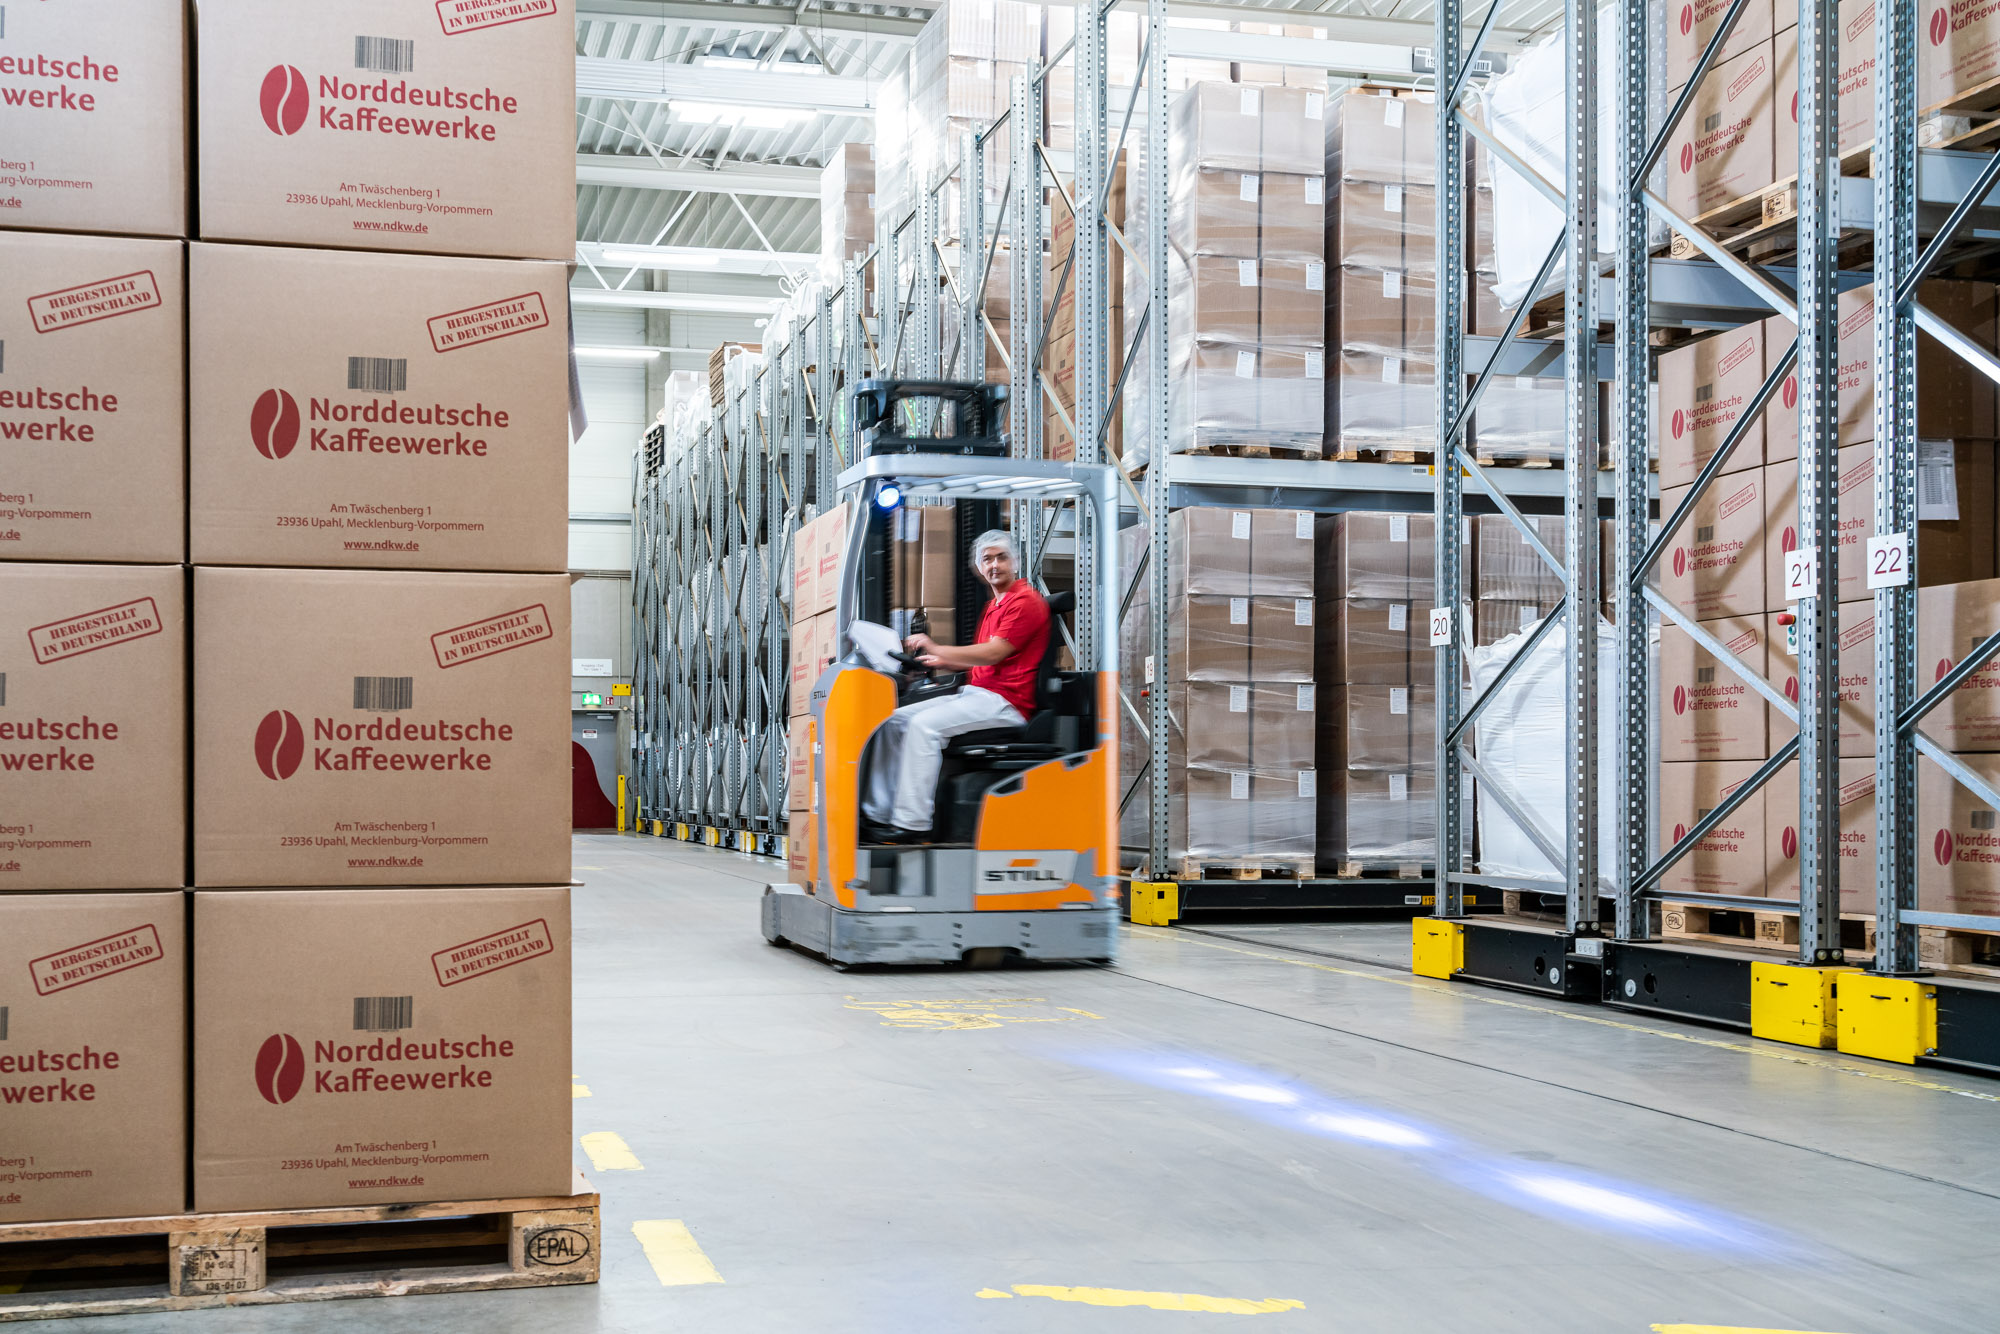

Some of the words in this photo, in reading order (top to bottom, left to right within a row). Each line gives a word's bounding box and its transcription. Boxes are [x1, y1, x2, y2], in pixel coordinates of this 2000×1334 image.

[449, 17, 463, 28] IN
[465, 0, 548, 25] DEUTSCHLAND
[319, 75, 518, 113] Norddeutsche
[319, 105, 496, 141] Kaffeewerke
[1694, 116, 1752, 150] Norddeutsche
[1694, 133, 1745, 165] Kaffeewerke
[29, 161, 35, 171] 1
[339, 182, 357, 193] Am
[359, 183, 433, 200] Twäschenberg
[435, 188, 441, 198] 1
[286, 193, 318, 205] 23936
[320, 195, 354, 208] Upahl,
[356, 198, 493, 216] Mecklenburg-Vorpommern
[353, 219, 429, 234] www.ndkw.de
[49, 280, 136, 309] HERGESTELLT
[42, 313, 58, 325] IN
[61, 291, 151, 322] DEUTSCHLAND
[446, 301, 526, 330] HERGESTELLT
[440, 333, 454, 346] IN
[457, 311, 540, 342] DEUTSCHLAND
[310, 397, 510, 428] Norddeutsche
[1686, 395, 1742, 419] Norddeutsche
[1686, 411, 1736, 432] Kaffeewerke
[310, 428, 487, 457] Kaffeewerke
[29, 493, 34, 503] 1
[330, 503, 348, 514] Am
[349, 504, 424, 517] Twäschenberg
[426, 505, 432, 515] 1
[276, 516, 309, 527] 23936
[311, 516, 344, 529] Upahl,
[346, 518, 484, 532] Mecklenburg-Vorpommern
[343, 538, 419, 551] www.ndkw.de
[1687, 539, 1744, 558] Norddeutsche
[1687, 554, 1737, 572] Kaffeewerke
[1873, 547, 1902, 575] 22
[1791, 562, 1811, 587] 21
[50, 608, 137, 640] HERGESTELLT
[450, 614, 530, 645] HERGESTELLT
[1433, 617, 1448, 636] 20
[43, 645, 58, 656] IN
[61, 618, 152, 651] DEUTSCHLAND
[444, 648, 458, 661] IN
[461, 624, 544, 657] DEUTSCHLAND
[1688, 683, 1745, 698] Norddeutsche
[1688, 698, 1738, 711] Kaffeewerke
[314, 717, 513, 742] Norddeutsche
[314, 746, 491, 771] Kaffeewerke
[28, 824, 34, 834] 1
[334, 822, 351, 832] Am
[353, 821, 428, 834] Twäschenberg
[430, 821, 436, 831] 1
[280, 836, 313, 847] 23936
[315, 836, 348, 848] Upahl,
[350, 835, 489, 848] Mecklenburg-Vorpommern
[347, 856, 424, 867] www.ndkw.de
[984, 870, 1063, 881] STILL
[50, 935, 138, 971] HERGESTELLT
[450, 929, 531, 963] HERGESTELLT
[43, 975, 59, 987] IN
[62, 945, 153, 983] DEUTSCHLAND
[444, 968, 459, 980] IN
[461, 938, 545, 974] DEUTSCHLAND
[314, 1034, 514, 1063] Norddeutsche
[314, 1064, 492, 1093] Kaffeewerke
[334, 1143, 352, 1154] Am
[354, 1141, 429, 1155] Twäschenberg
[431, 1140, 437, 1150] 1
[29, 1156, 34, 1166] 1
[280, 1159, 313, 1170] 23936
[316, 1157, 349, 1171] Upahl,
[351, 1153, 489, 1169] Mecklenburg-Vorpommern
[348, 1175, 424, 1189] www.ndkw.de
[537, 1237, 580, 1258] EPAL
